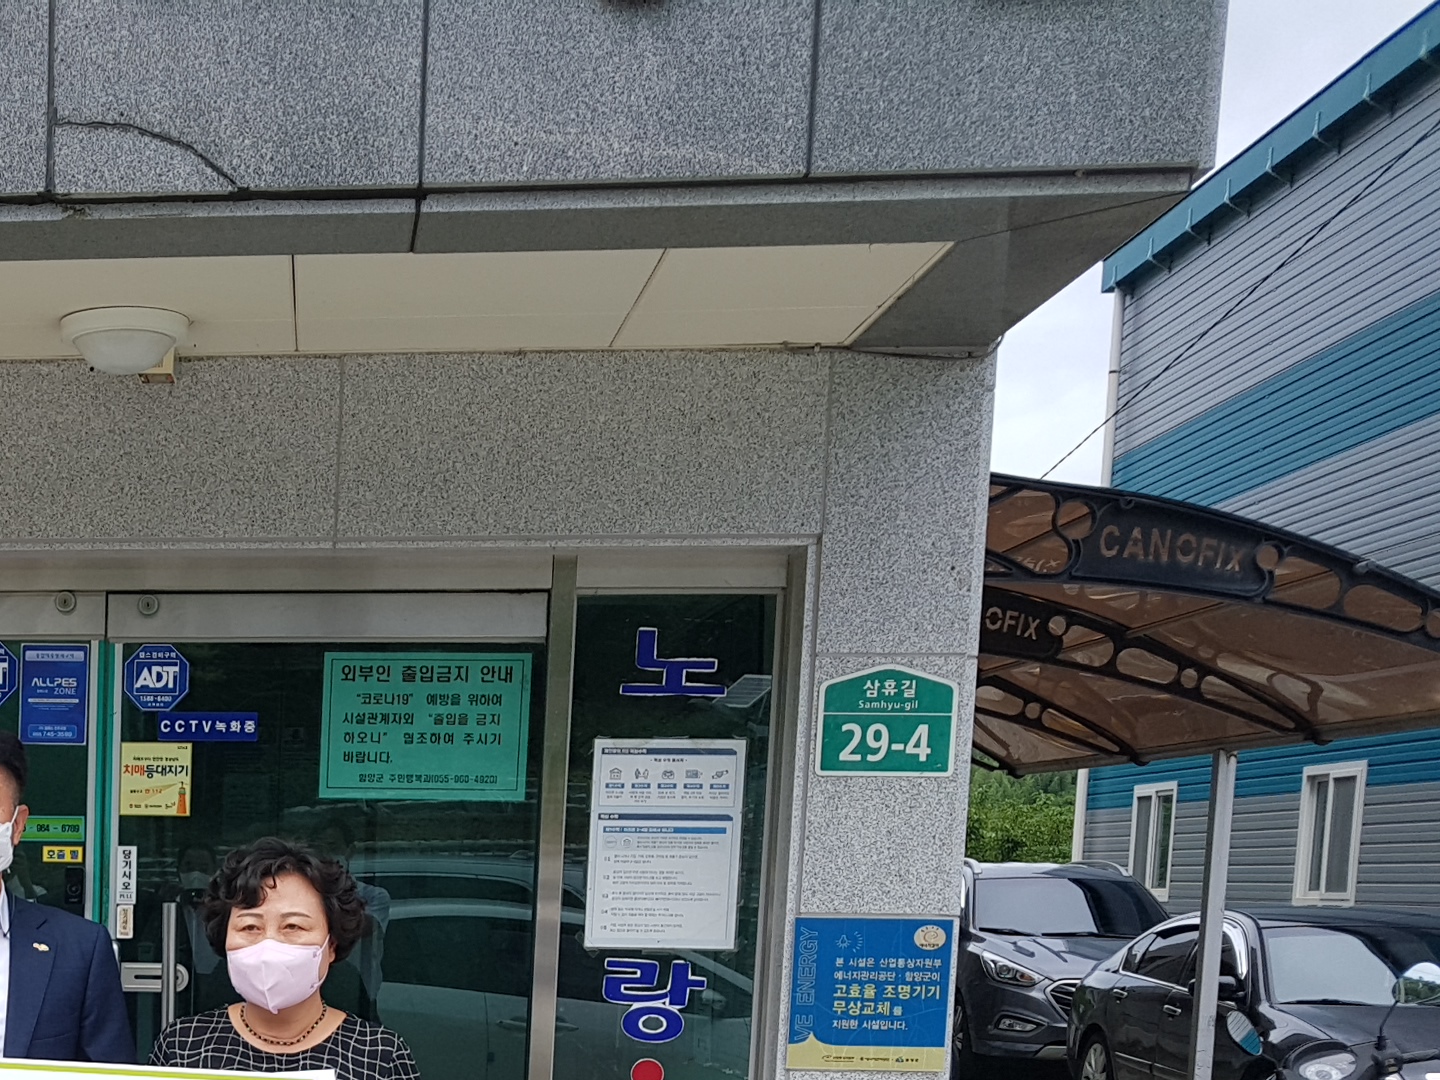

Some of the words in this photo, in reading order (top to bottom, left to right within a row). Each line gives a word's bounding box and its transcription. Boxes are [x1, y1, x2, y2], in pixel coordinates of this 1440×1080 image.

[1098, 523, 1242, 573] CANOFIX
[985, 606, 1041, 641] OFIX
[134, 665, 179, 689] ADT
[340, 664, 392, 683] 외부인
[401, 664, 470, 684] 출입금지
[479, 665, 513, 684] 안내
[53, 687, 77, 696] ZONE
[862, 679, 918, 698] 삼휴길
[425, 692, 462, 707] 예방을
[467, 693, 503, 707] 위하여
[857, 699, 919, 712] Samhyu-gil
[475, 712, 501, 726] 금지
[403, 732, 455, 746] 협조하여
[462, 732, 502, 746] 주시기
[838, 722, 932, 763] 29-4
[123, 763, 189, 779] 치매등대지기
[121, 849, 132, 891] 당기시오
[833, 970, 896, 982] 에너지관리공단
[832, 983, 877, 999] 고효율
[882, 984, 941, 1000] 조명기기
[831, 1019, 859, 1030] 지원한
